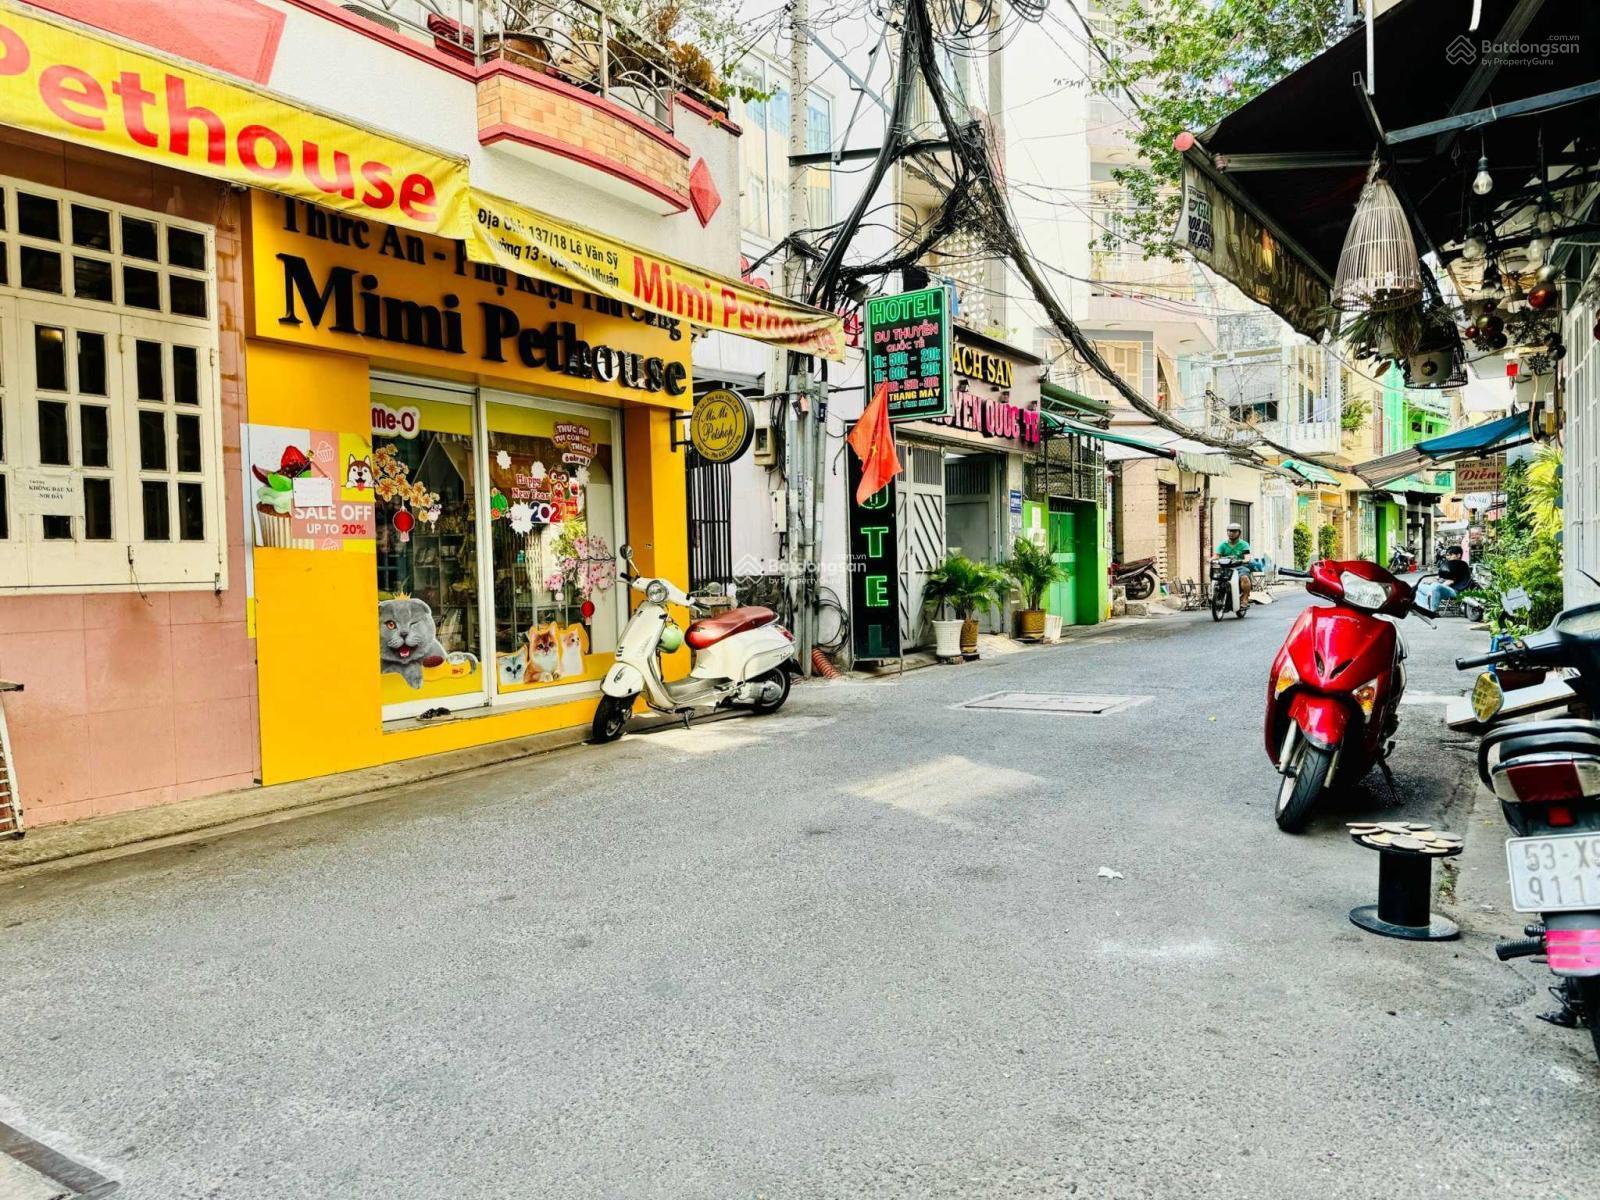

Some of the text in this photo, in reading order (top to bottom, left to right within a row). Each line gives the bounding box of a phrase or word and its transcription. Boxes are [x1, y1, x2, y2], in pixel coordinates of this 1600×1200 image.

[478, 208, 499, 229] Địa
[529, 225, 567, 250] 137/18
[570, 239, 582, 255] Lê
[585, 243, 604, 264] Văn
[606, 250, 618, 269] Sỹ
[525, 245, 540, 261] 13
[633, 256, 713, 324] Mimi
[871, 293, 940, 325] HOTEL
[276, 253, 688, 396] Mimi Pethouse
[874, 331, 890, 344] DU
[953, 336, 983, 379] ÁCH
[889, 391, 917, 402] THANG
[372, 407, 415, 432] Me-O
[511, 487, 530, 498] New
[294, 505, 371, 521] SALE OFF
[306, 524, 366, 535] UP TO 20%
[1528, 873, 1600, 905] 911
